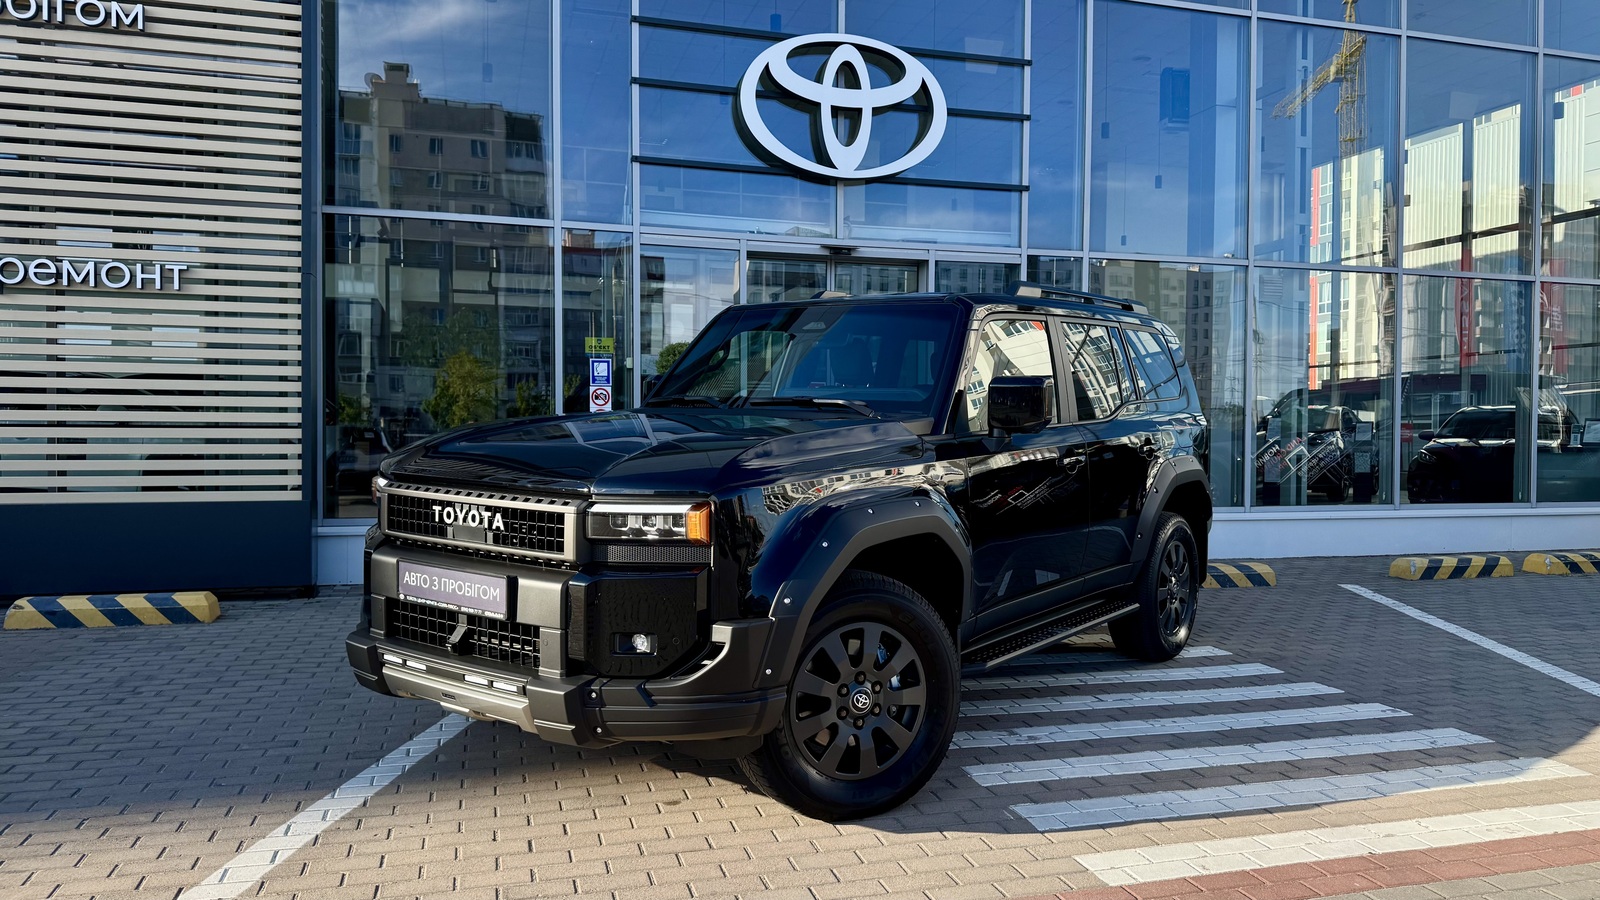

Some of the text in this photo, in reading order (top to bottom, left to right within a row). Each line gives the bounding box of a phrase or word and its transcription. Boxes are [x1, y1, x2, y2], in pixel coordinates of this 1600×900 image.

[432, 505, 504, 531] TOYOTA
[403, 571, 430, 588] АВТО
[441, 578, 500, 602] ПРОБІГОМ
